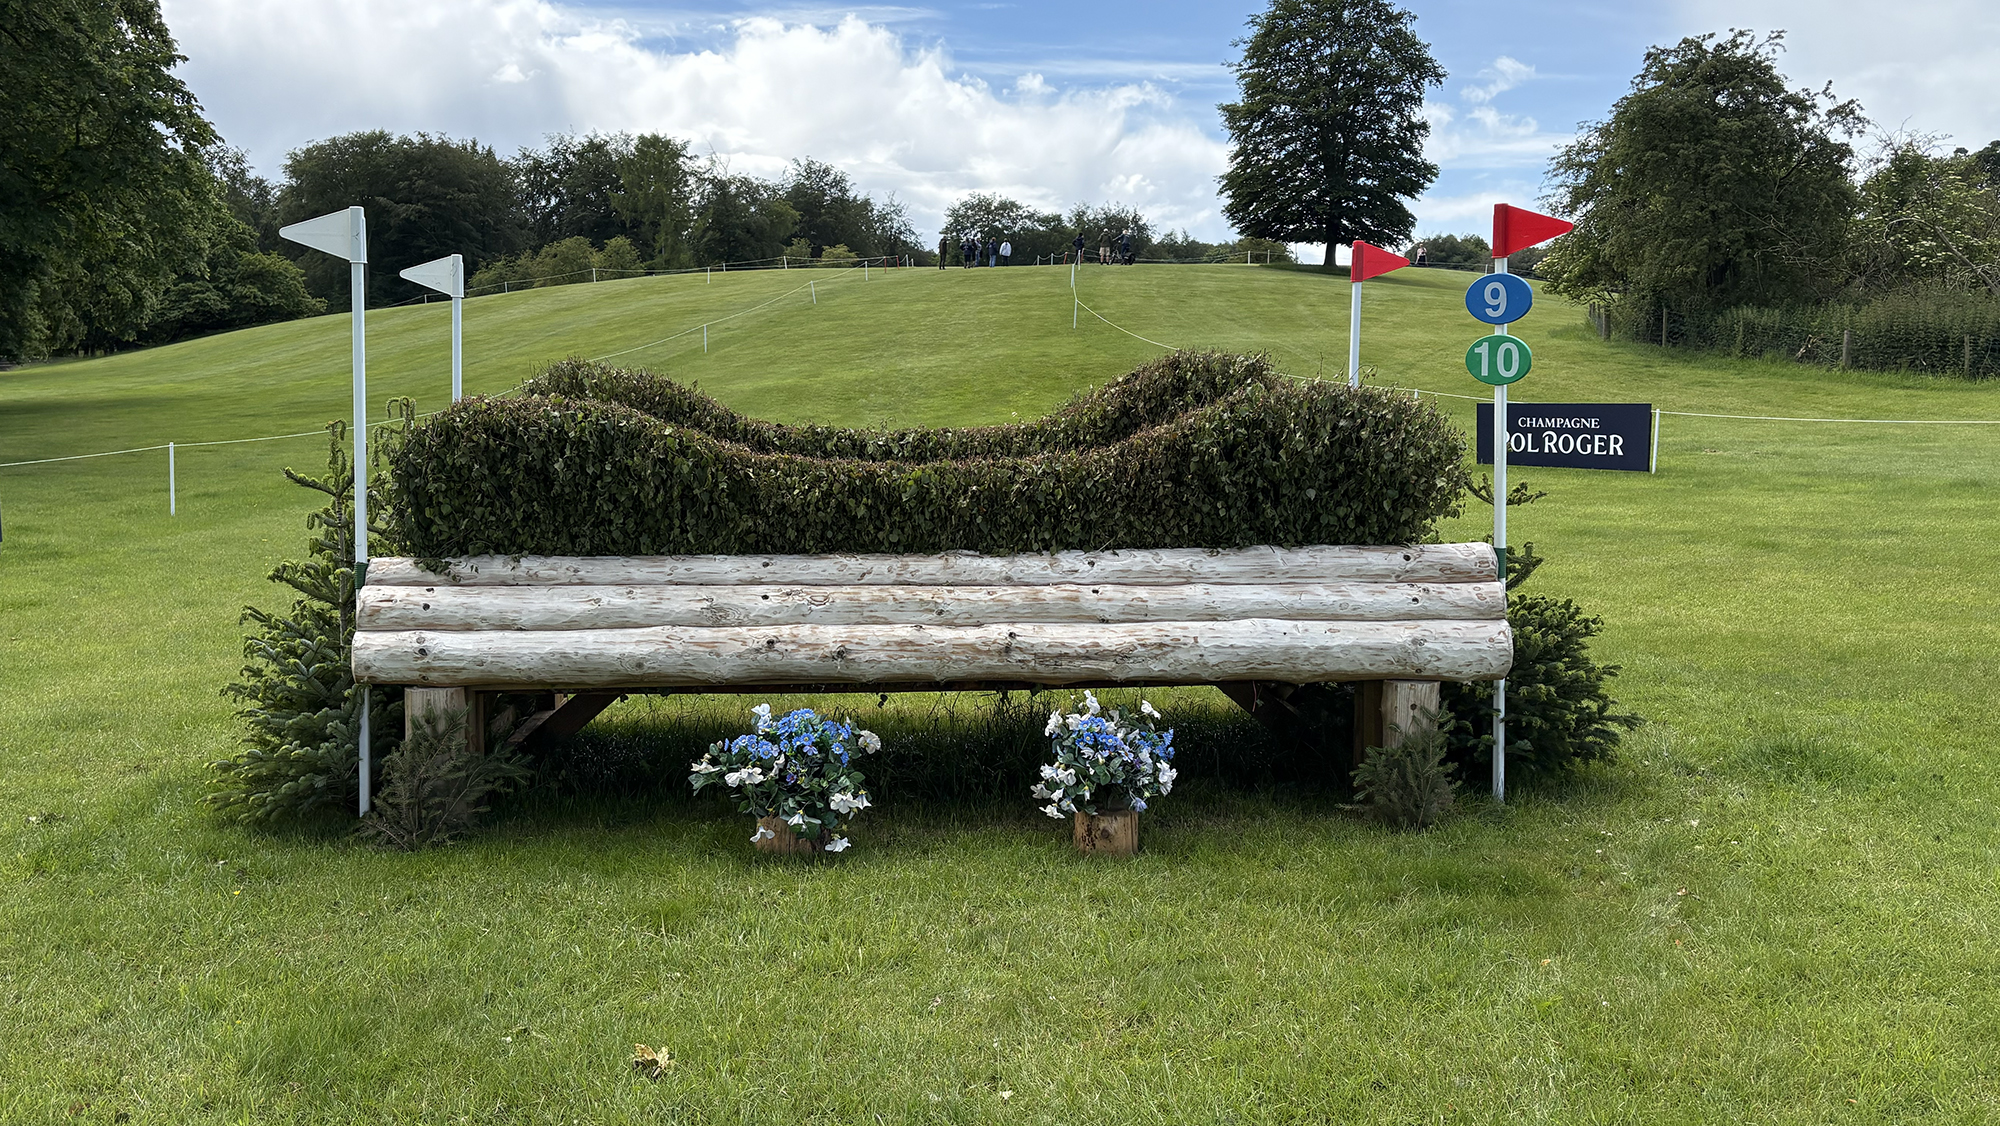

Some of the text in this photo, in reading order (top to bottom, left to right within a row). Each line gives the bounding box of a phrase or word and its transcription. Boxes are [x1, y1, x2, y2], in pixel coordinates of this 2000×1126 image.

[1484, 282, 1507, 317] 9
[1474, 342, 1519, 378] 10
[1518, 417, 1600, 429] CHAMPAGNE
[1542, 431, 1624, 456] ROGER
